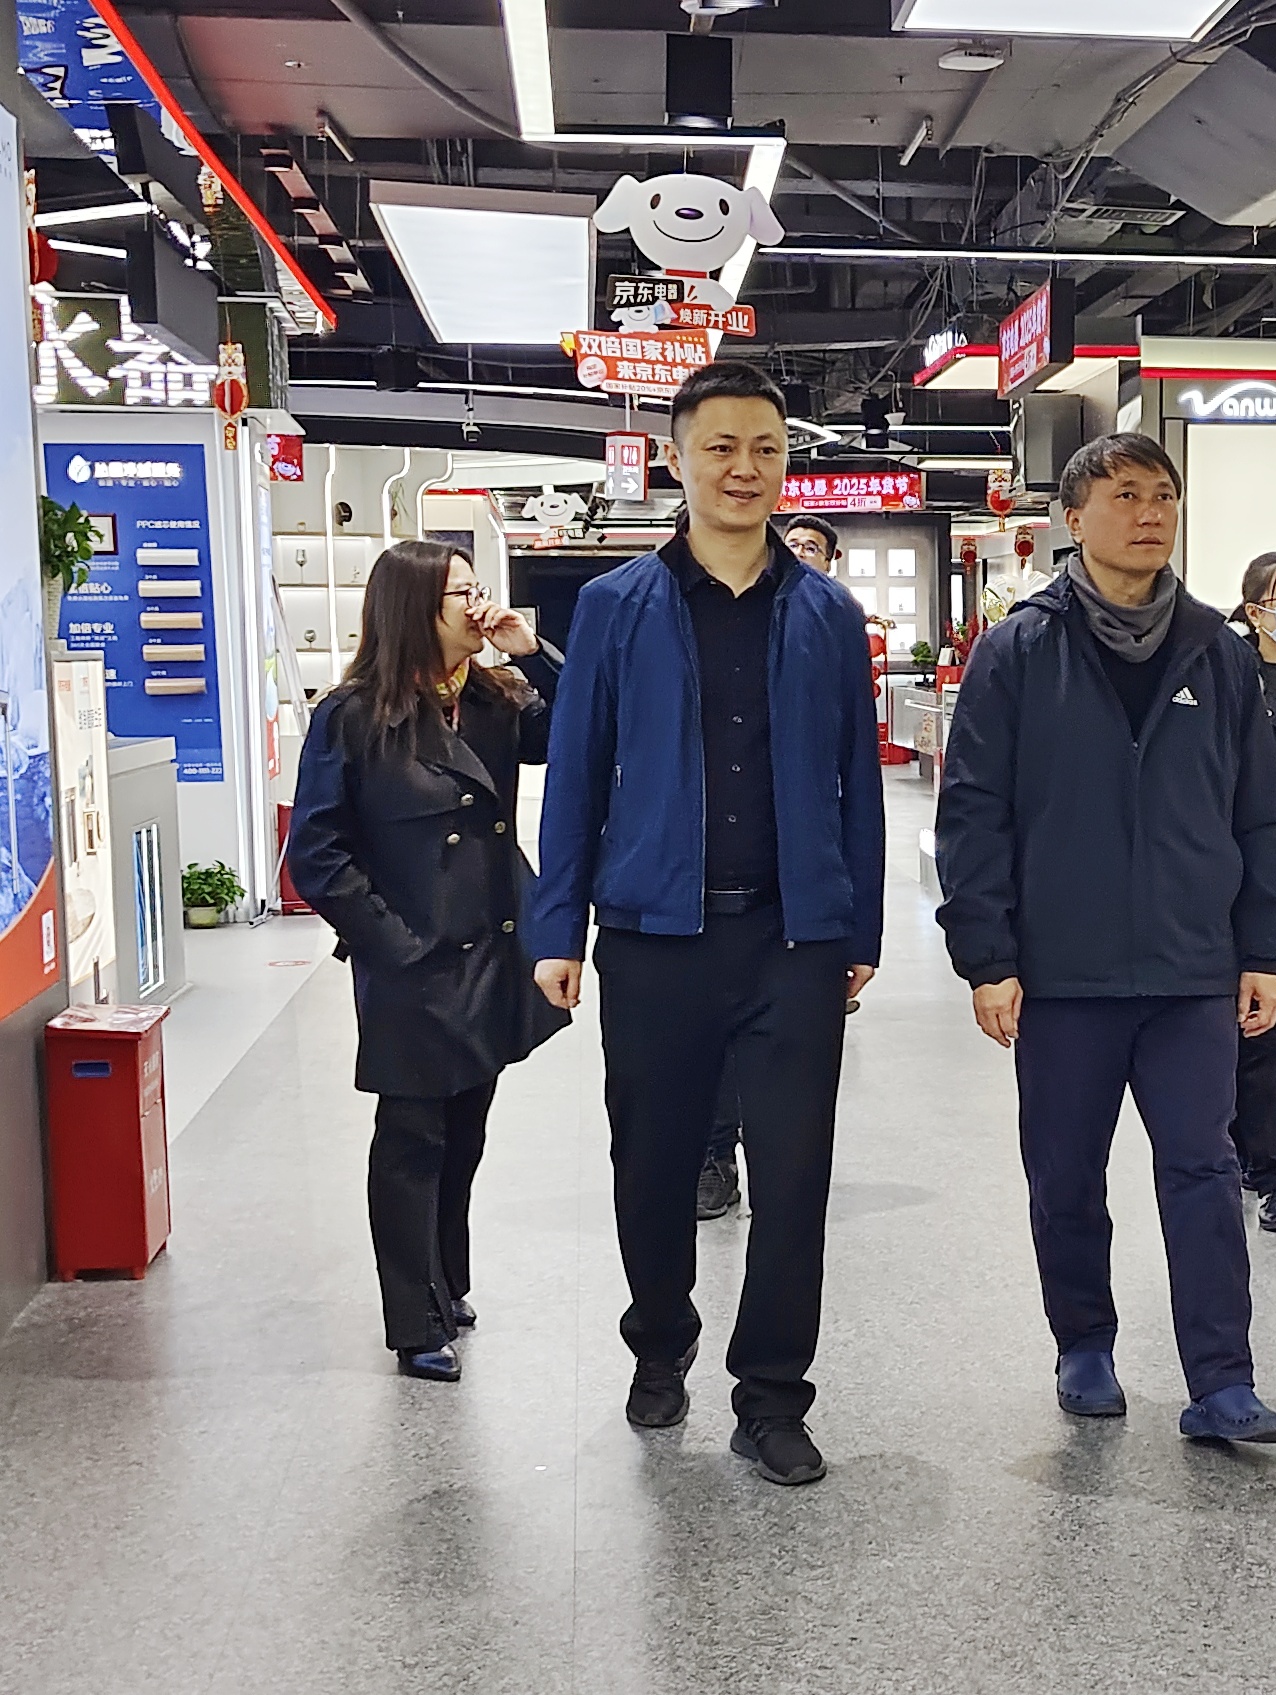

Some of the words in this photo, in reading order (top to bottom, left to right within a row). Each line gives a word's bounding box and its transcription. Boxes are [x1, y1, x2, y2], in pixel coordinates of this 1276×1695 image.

[612, 280, 678, 305] 京东电器
[679, 307, 751, 333] 焕新开业
[579, 333, 707, 365] 双倍国家补贴
